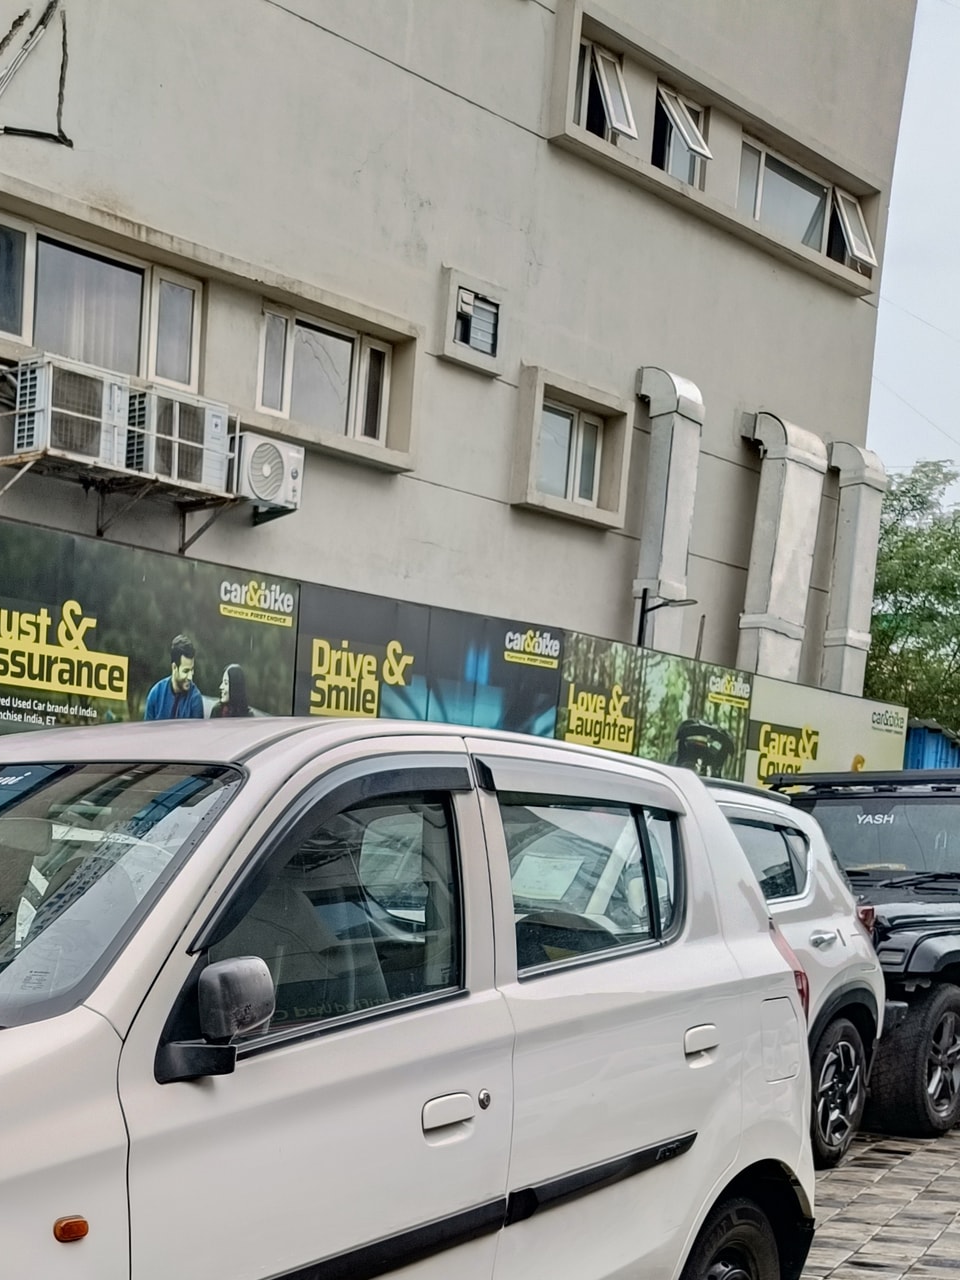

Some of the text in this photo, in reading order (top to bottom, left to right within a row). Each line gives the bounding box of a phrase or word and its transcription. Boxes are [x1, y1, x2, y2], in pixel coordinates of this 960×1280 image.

[57, 600, 97, 652] &
[312, 639, 414, 686] Drive &
[12, 697, 32, 709] Used
[33, 700, 45, 711] Car
[47, 701, 68, 714] brand
[70, 705, 78, 715] of
[79, 706, 97, 718] India
[310, 673, 376, 714] Smile
[568, 683, 630, 718] Love &
[24, 713, 45, 726] India,
[46, 716, 56, 726] ET
[567, 709, 633, 745] Laughter
[759, 724, 818, 760] Care &
[856, 814, 894, 824] YASH
